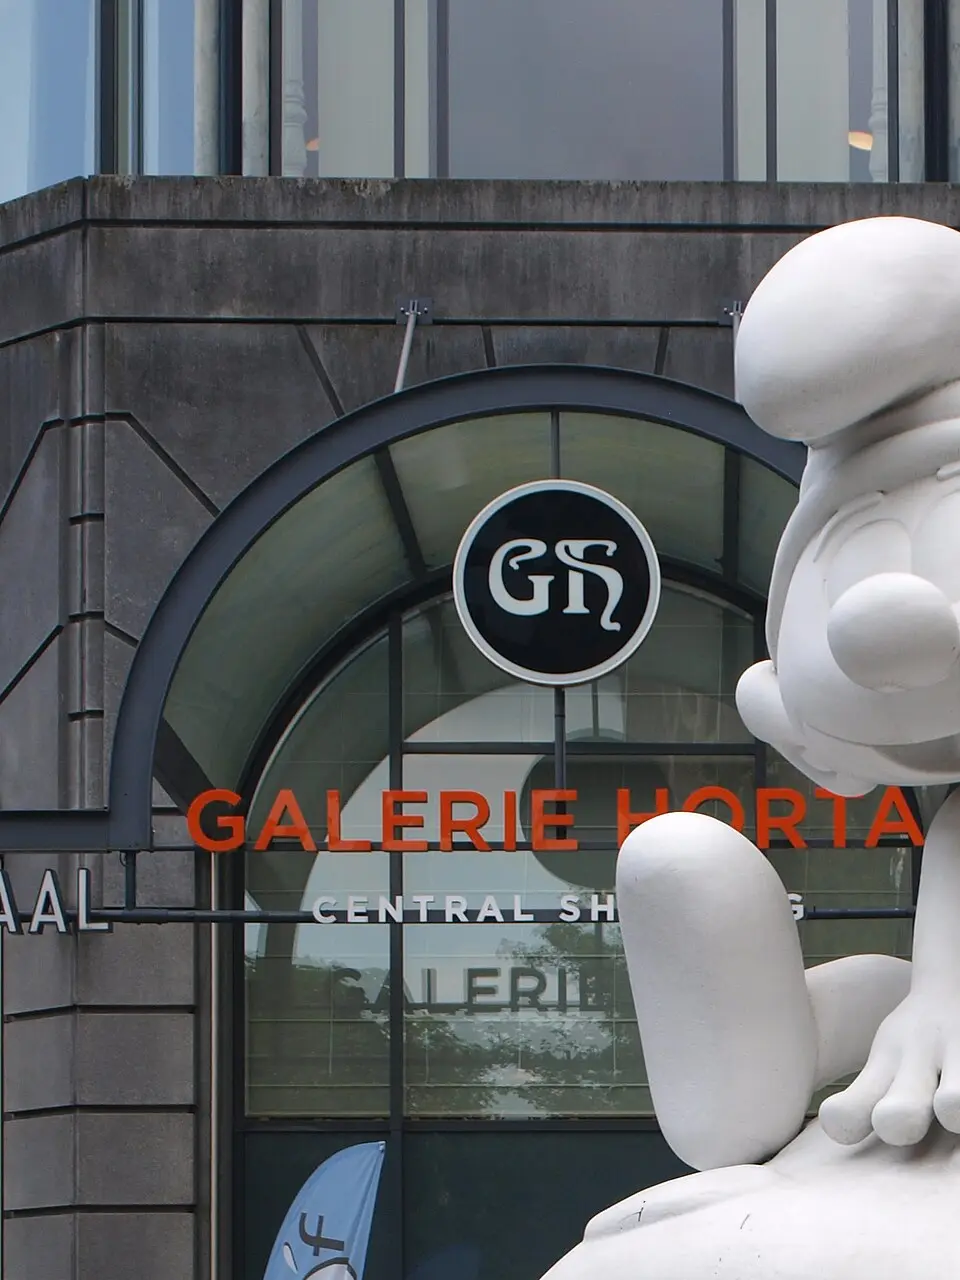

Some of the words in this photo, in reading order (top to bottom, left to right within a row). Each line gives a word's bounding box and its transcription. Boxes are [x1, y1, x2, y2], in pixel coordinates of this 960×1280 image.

[186, 788, 579, 852] GALERIE
[616, 785, 925, 849] HORTA
[312, 896, 534, 923] CENTRAL
